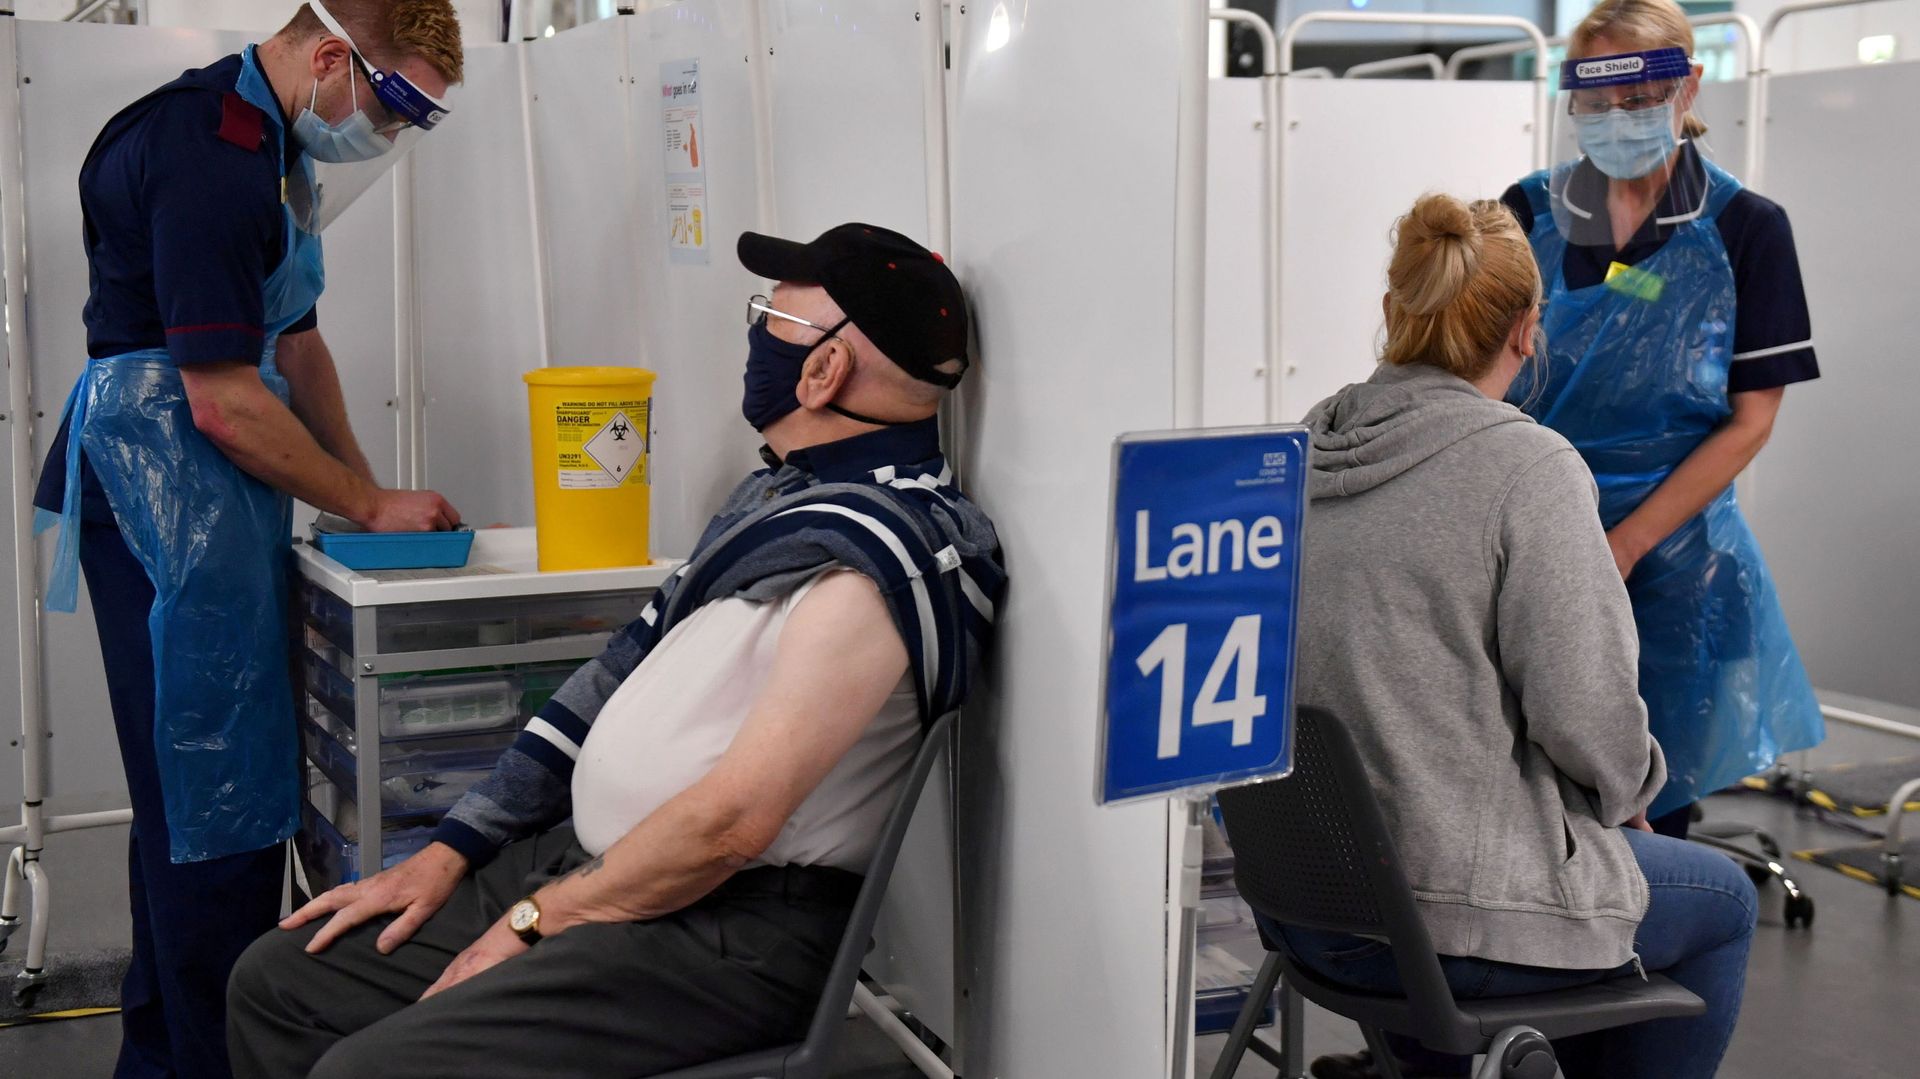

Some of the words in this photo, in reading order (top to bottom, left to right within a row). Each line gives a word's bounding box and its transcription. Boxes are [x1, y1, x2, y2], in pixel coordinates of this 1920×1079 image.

[1578, 64, 1601, 75] Face
[1605, 59, 1640, 73] Shield
[556, 415, 590, 423] DANGER
[616, 465, 622, 473] 6
[1134, 510, 1284, 583] Lane
[1136, 614, 1267, 760] 14
